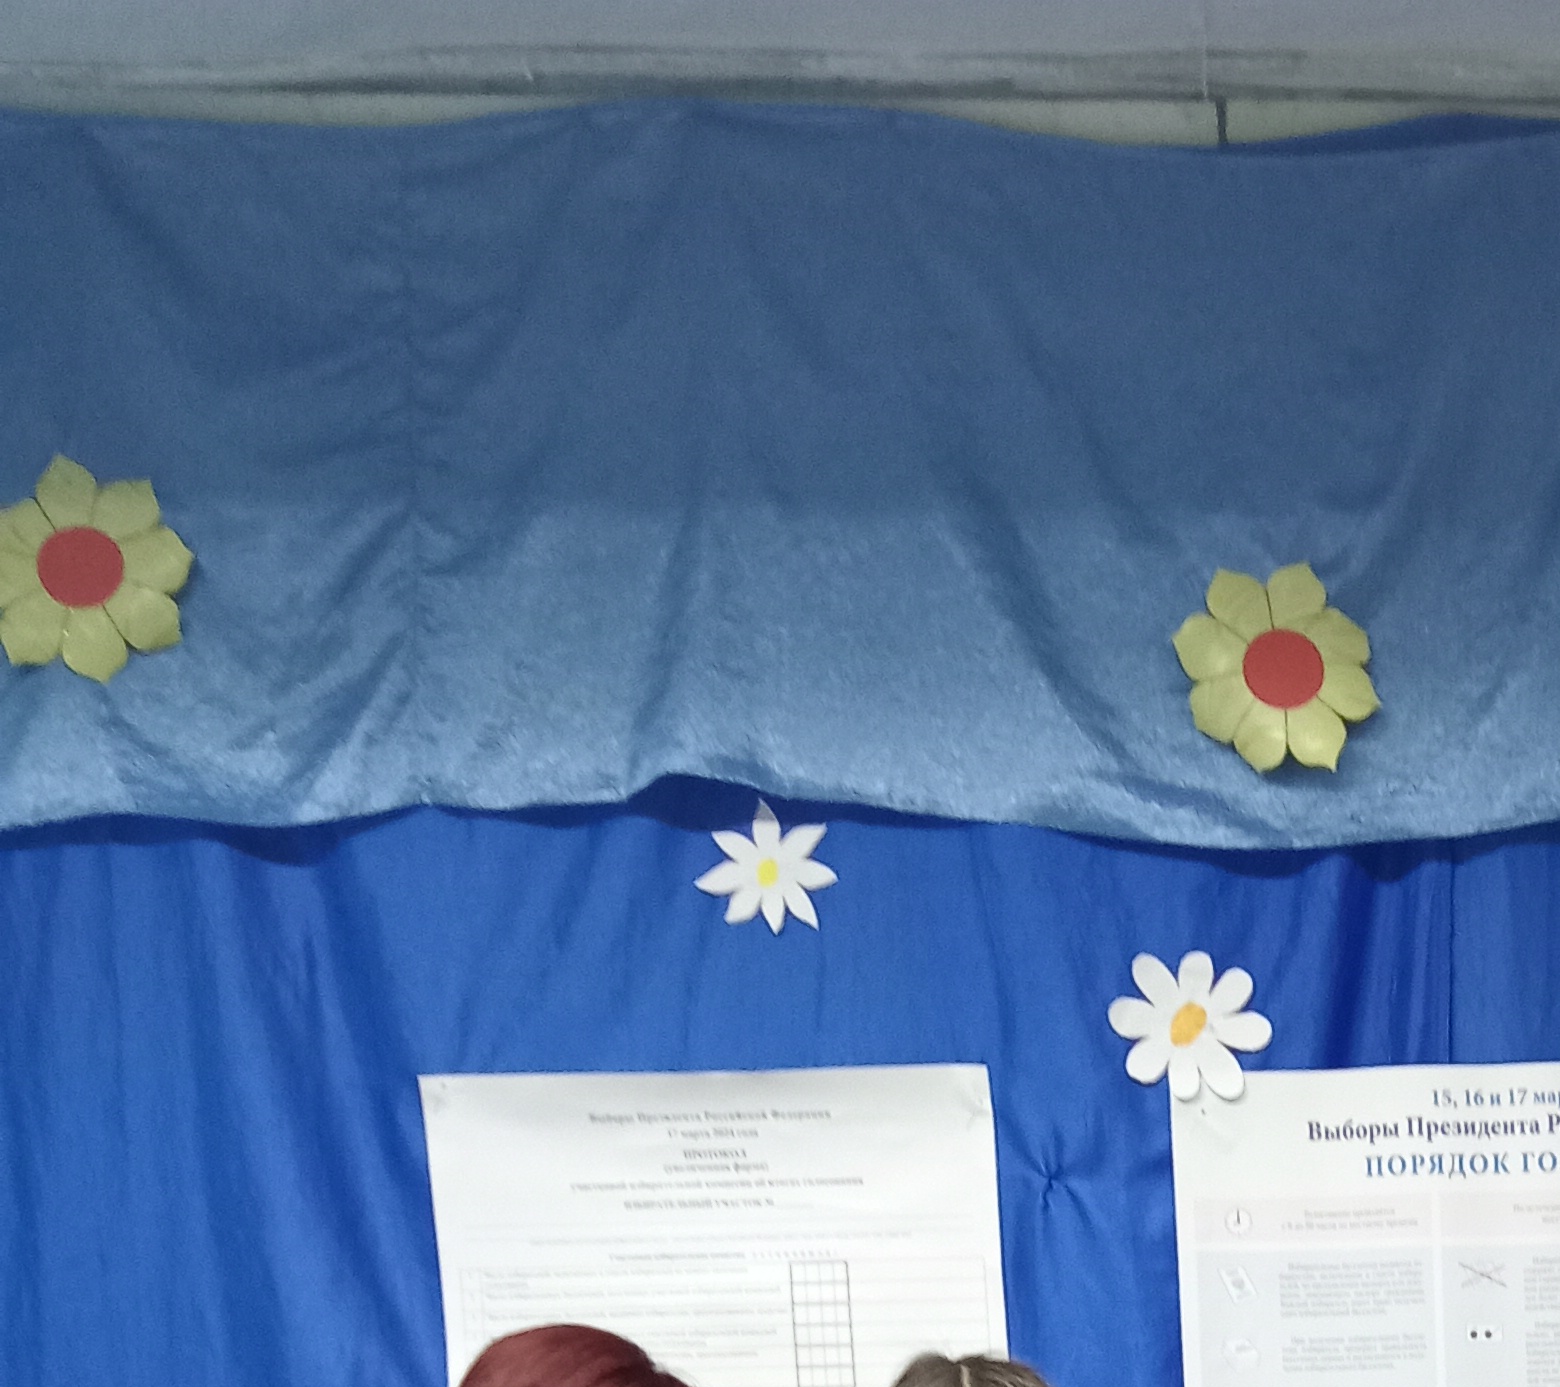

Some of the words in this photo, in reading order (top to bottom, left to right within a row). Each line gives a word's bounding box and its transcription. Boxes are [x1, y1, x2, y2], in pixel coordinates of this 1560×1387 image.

[1432, 1088, 1458, 1109] 15,
[1464, 1088, 1485, 1107] 16
[1489, 1092, 1501, 1107] и
[1508, 1087, 1528, 1107] 17
[1307, 1118, 1399, 1145] Выборы
[1406, 1114, 1541, 1143] Президента
[1365, 1151, 1510, 1179] ПОРЯДОК
